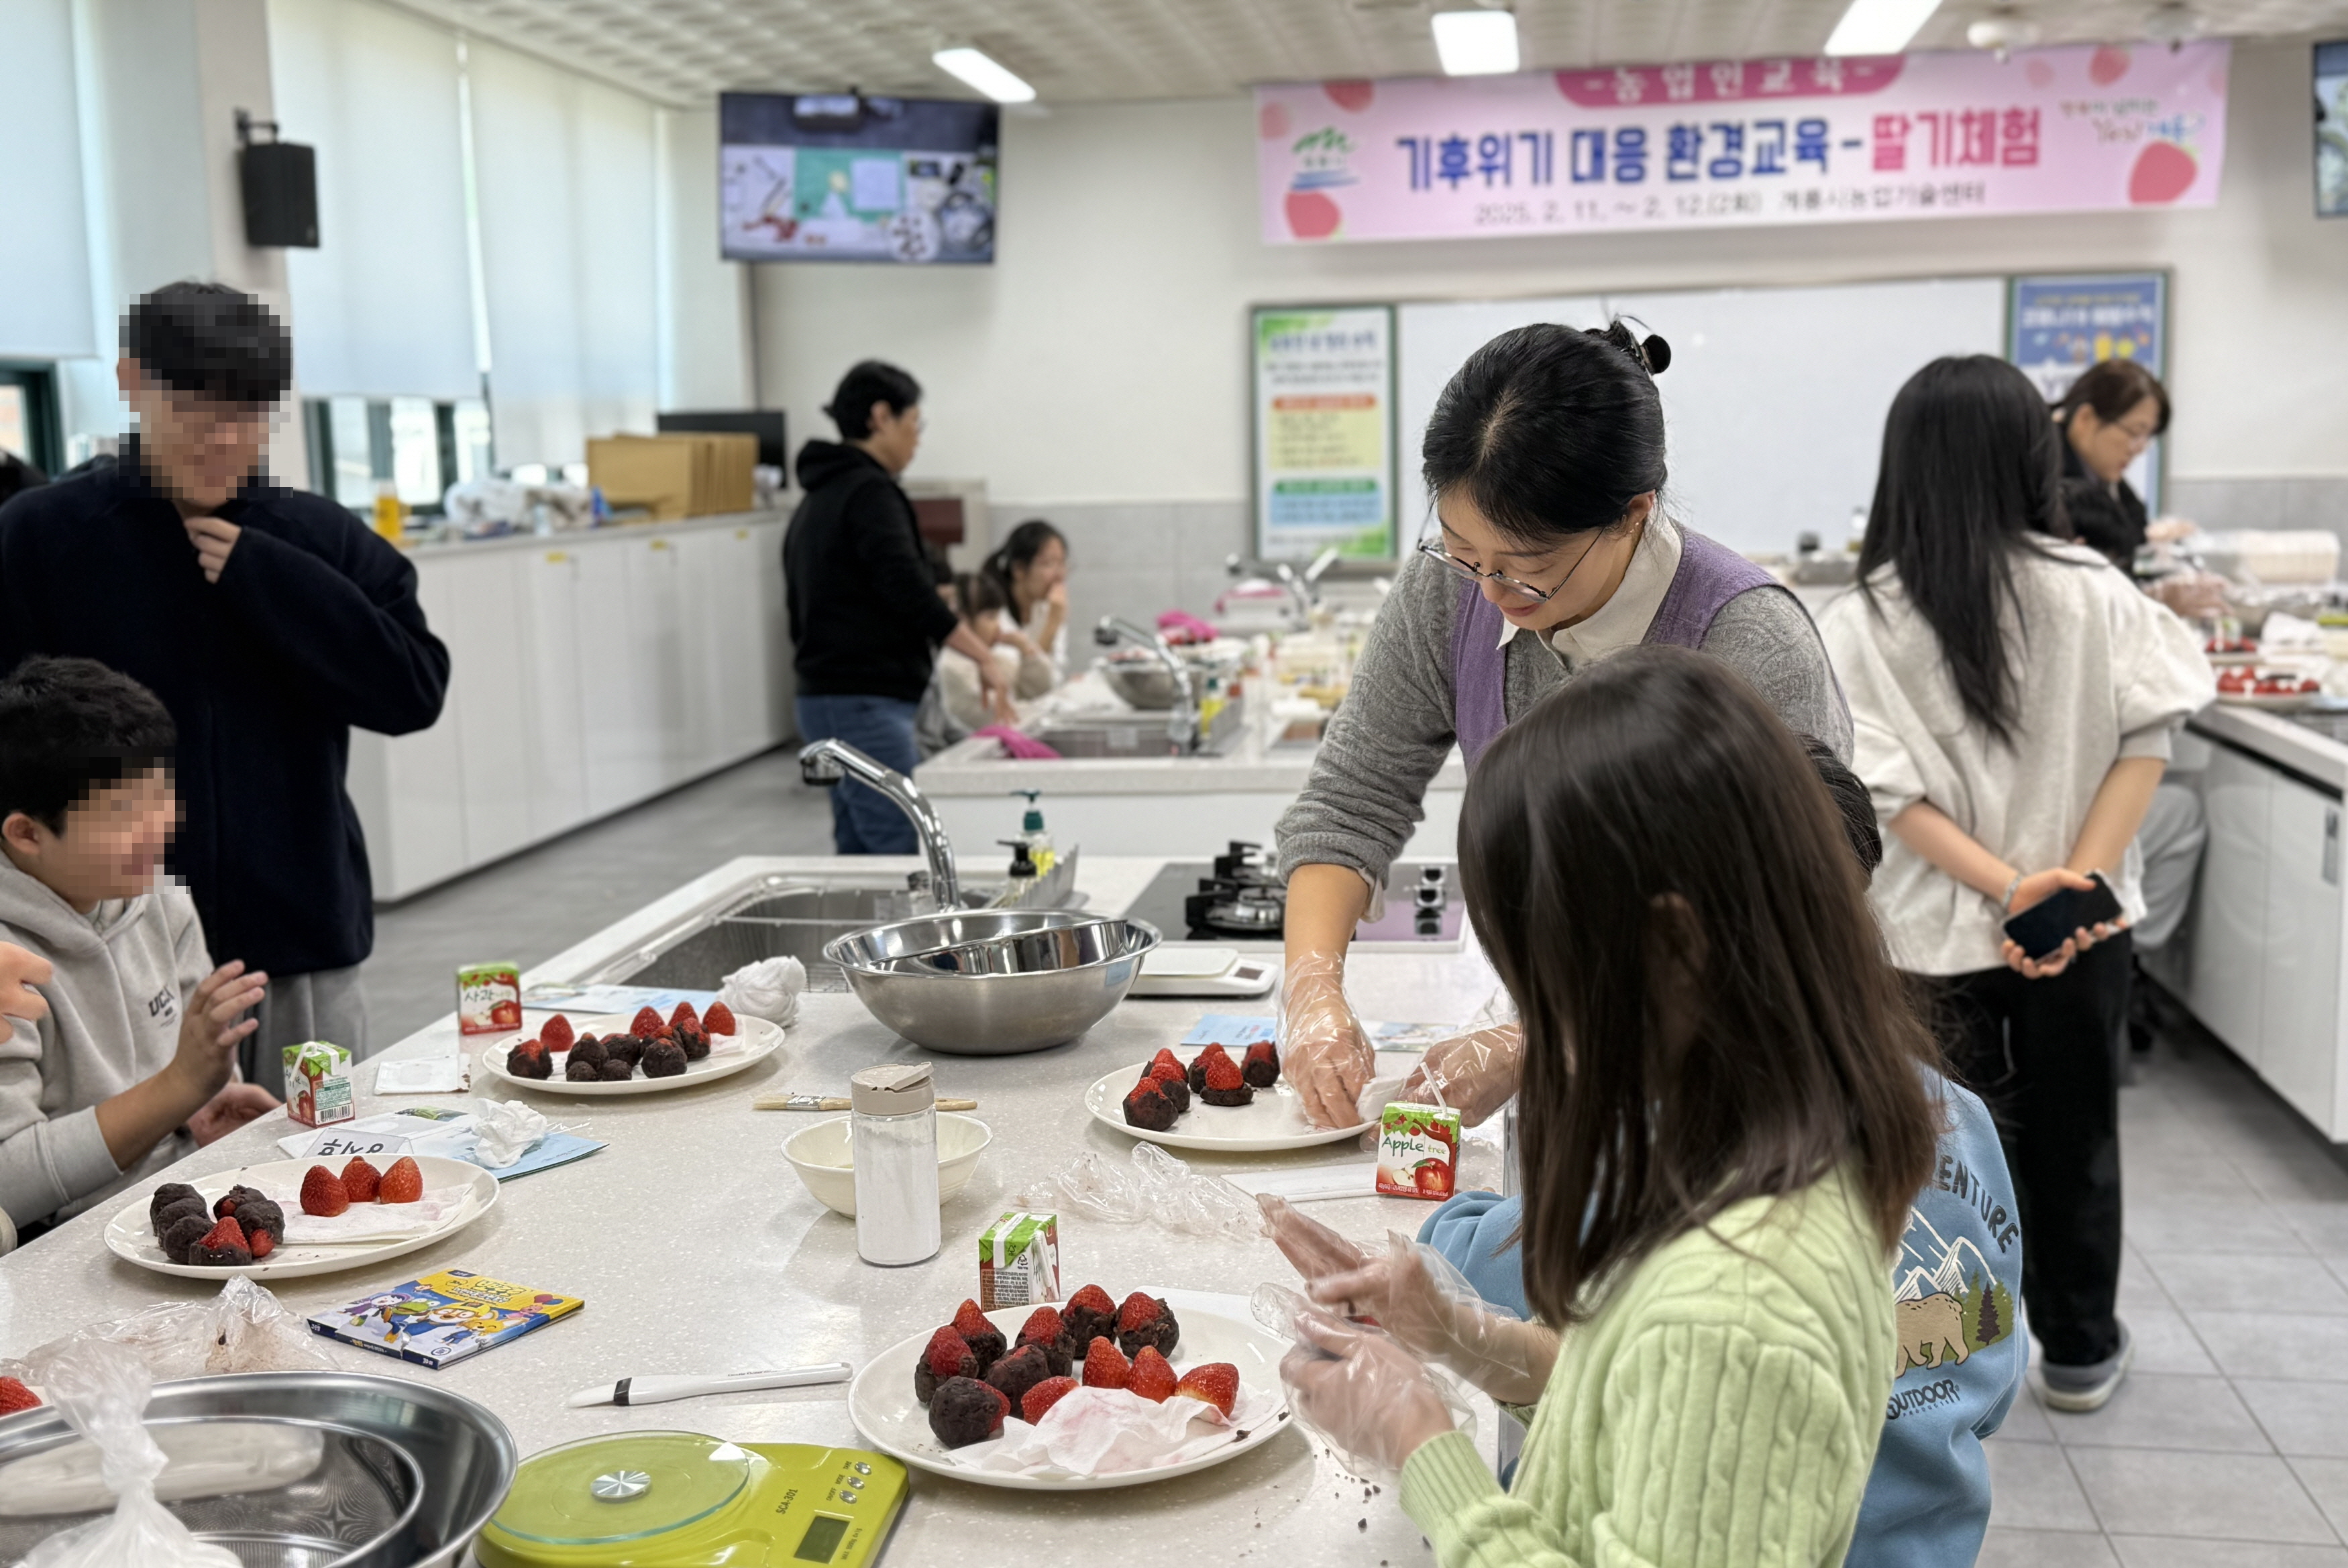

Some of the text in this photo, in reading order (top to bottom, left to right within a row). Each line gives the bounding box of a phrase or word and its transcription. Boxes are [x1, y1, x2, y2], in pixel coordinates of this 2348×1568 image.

[1396, 129, 1552, 190] 기후위기
[1571, 127, 1649, 184] 대응
[1382, 1136, 1424, 1157] Apple
[776, 1489, 798, 1514] SCA-301
